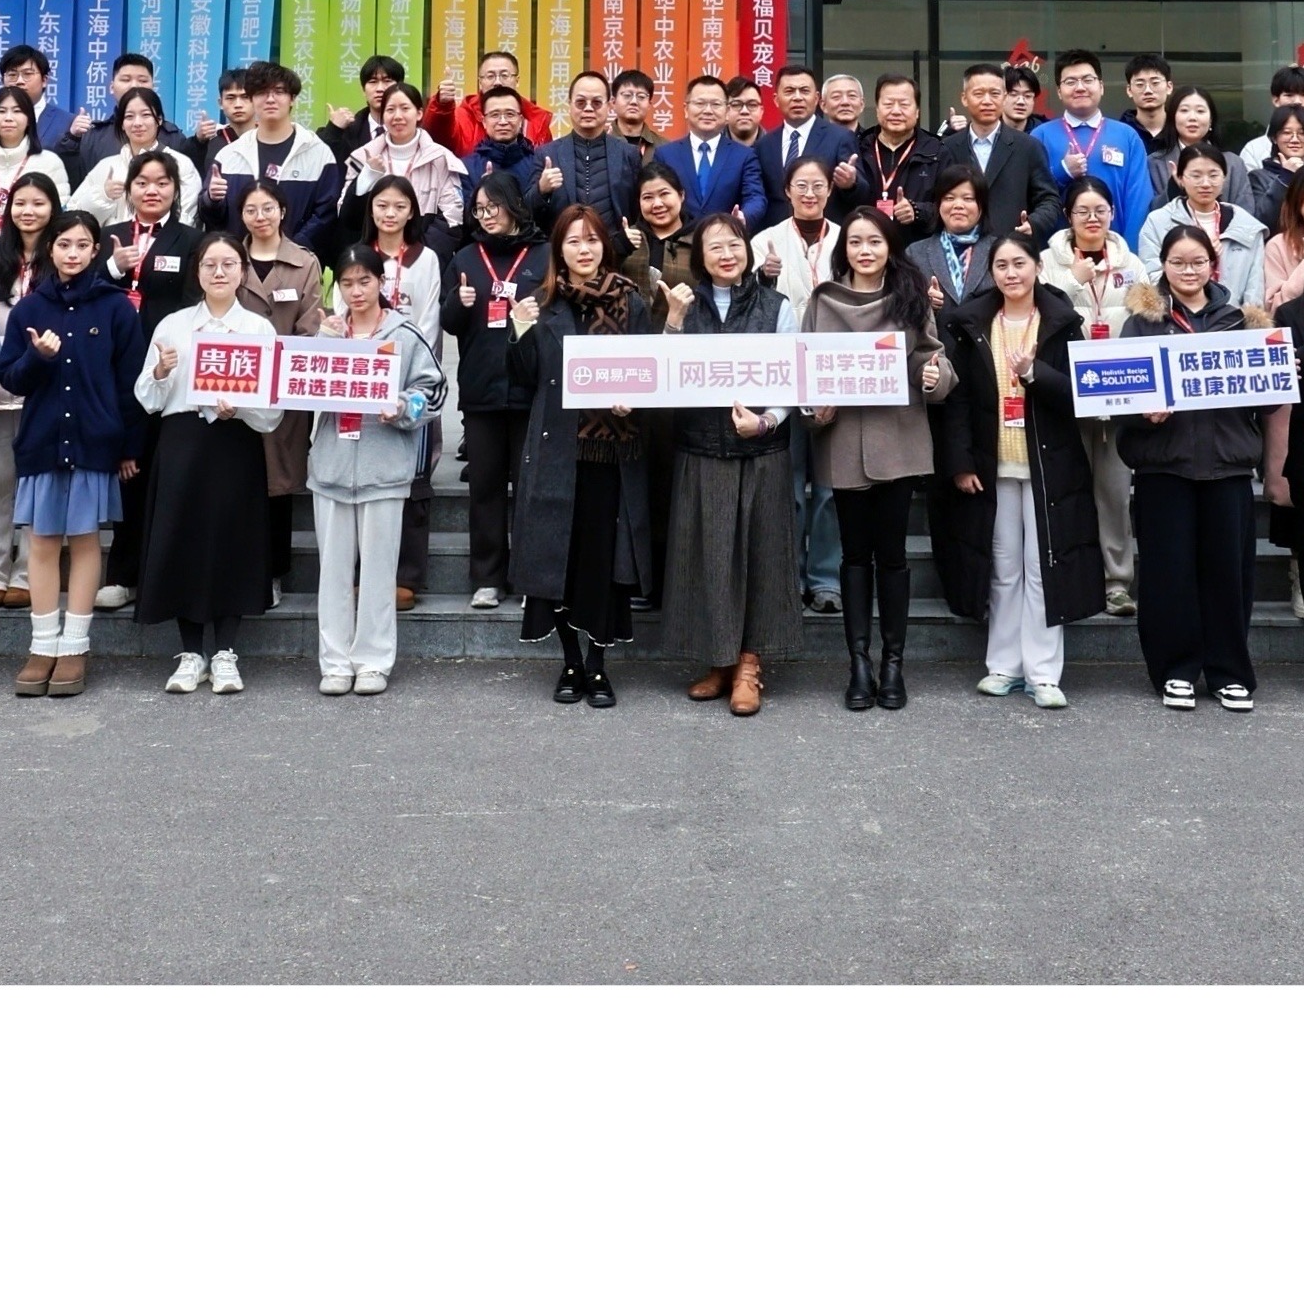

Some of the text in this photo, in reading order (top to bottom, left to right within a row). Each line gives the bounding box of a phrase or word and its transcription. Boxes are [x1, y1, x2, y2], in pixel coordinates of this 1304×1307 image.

[198, 347, 258, 379] 贵族
[290, 354, 392, 378] 宠物要富养
[815, 353, 897, 372] 科学守护
[1179, 346, 1289, 372] 低敏耐吉斯
[596, 367, 653, 384] 网易严选
[679, 360, 792, 389] 网易天成
[1101, 367, 1148, 377] Holistic Recipe
[1101, 374, 1149, 386] SOLUTION
[287, 377, 390, 401] 就选贵族粮
[816, 376, 899, 395] 更懂彼此
[1182, 371, 1293, 398] 健康放心吃
